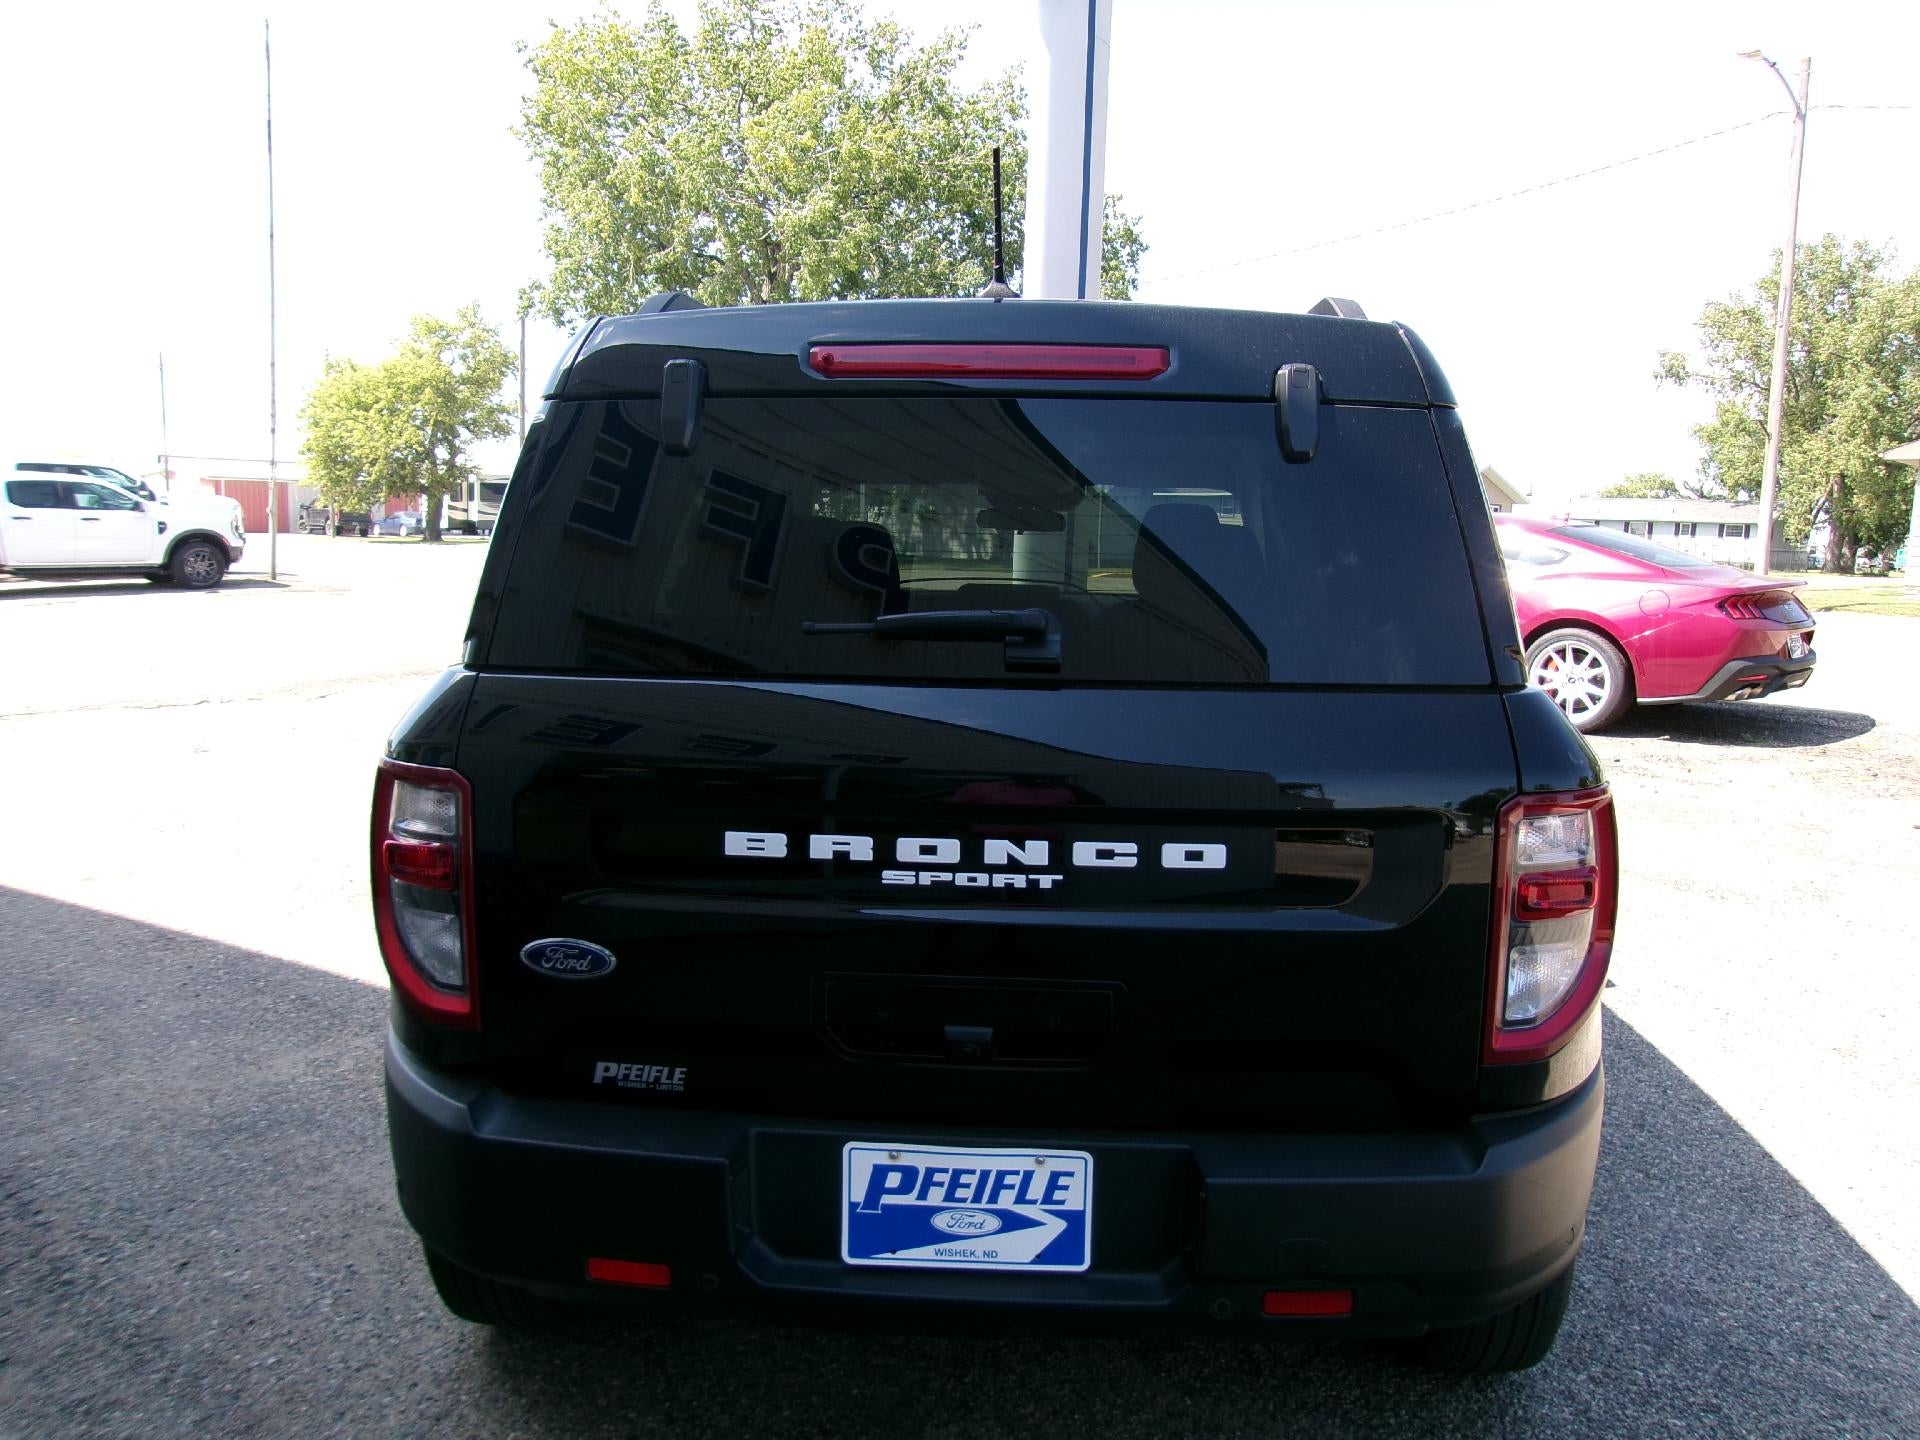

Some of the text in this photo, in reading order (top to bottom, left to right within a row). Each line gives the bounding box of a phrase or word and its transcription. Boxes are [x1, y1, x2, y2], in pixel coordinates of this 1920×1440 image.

[724, 831, 1228, 869] BRONCO
[881, 870, 1064, 889] SPORT
[541, 946, 593, 970] Ford
[592, 1061, 688, 1084] PFEIFLE
[856, 1163, 1076, 1213] PFEIFLE
[946, 1213, 987, 1230] Ford
[934, 1248, 999, 1259] WISHEK, ND
